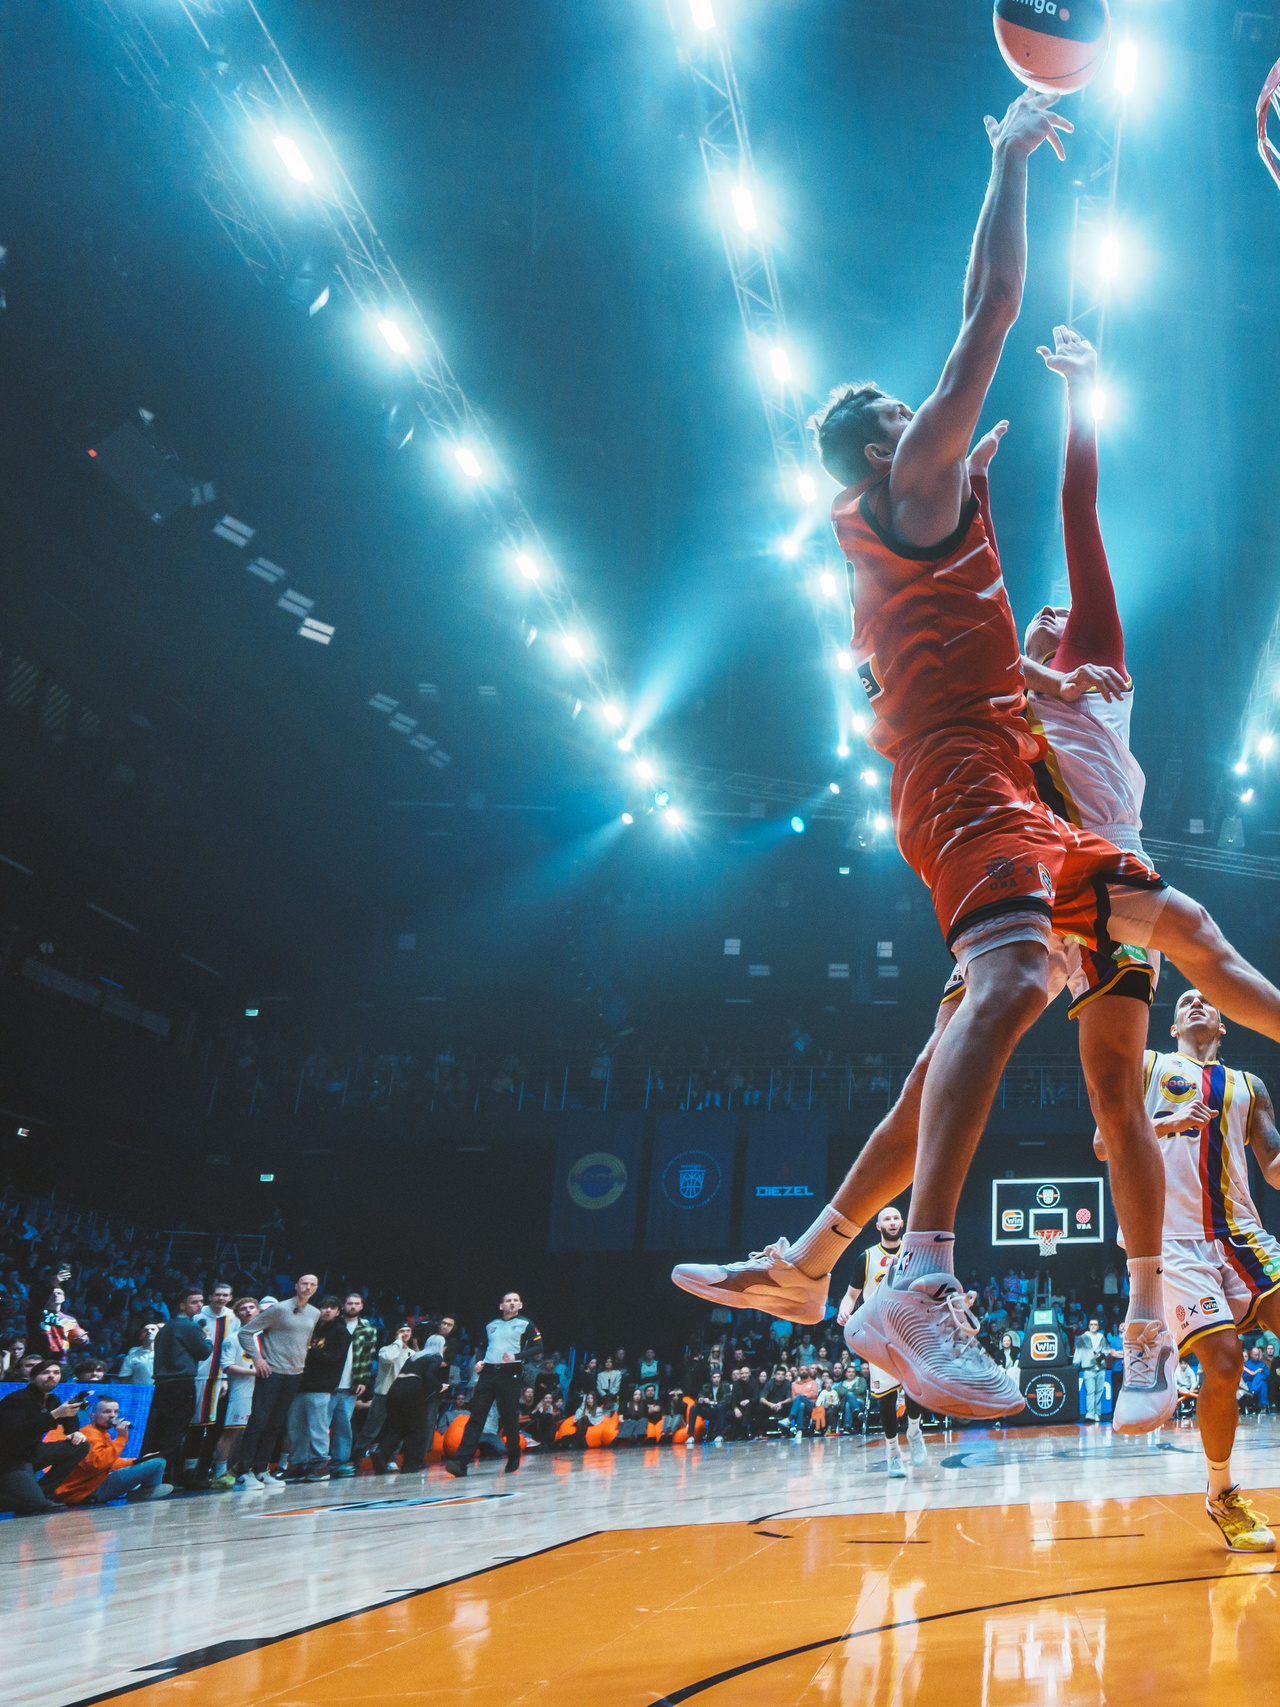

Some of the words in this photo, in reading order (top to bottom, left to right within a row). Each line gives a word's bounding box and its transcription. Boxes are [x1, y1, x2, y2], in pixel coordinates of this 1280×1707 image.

[989, 878, 1018, 890] UBA
[755, 1186, 814, 1197] DIEZEL
[1007, 1217, 1022, 1225] Win
[1037, 1342, 1055, 1351] Win
